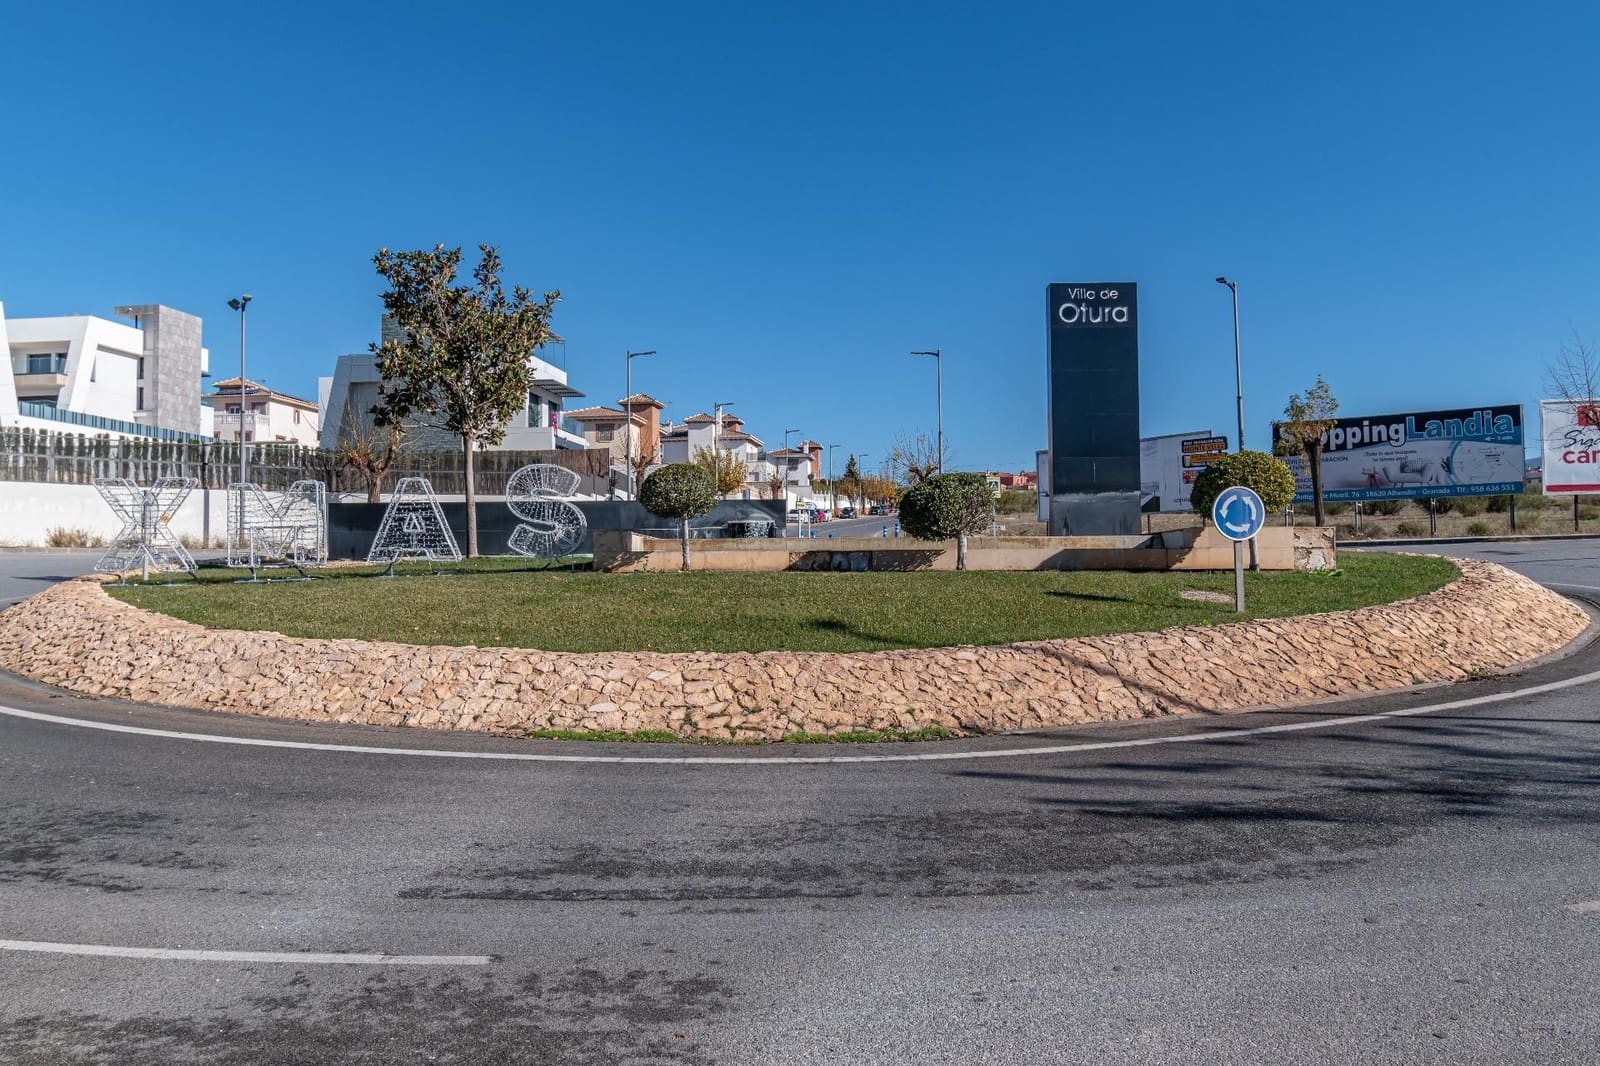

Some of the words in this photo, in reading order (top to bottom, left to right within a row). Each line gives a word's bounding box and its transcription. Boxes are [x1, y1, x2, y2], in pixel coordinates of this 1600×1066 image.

[1068, 288, 1095, 299] Villa
[1100, 288, 1118, 299] de
[1059, 302, 1129, 323] Otura
[1279, 410, 1514, 449] SoppingLandia
[1422, 486, 1450, 495] Granada
[1471, 485, 1484, 493] 958
[1486, 484, 1499, 492] 636
[1501, 483, 1516, 491] 551
